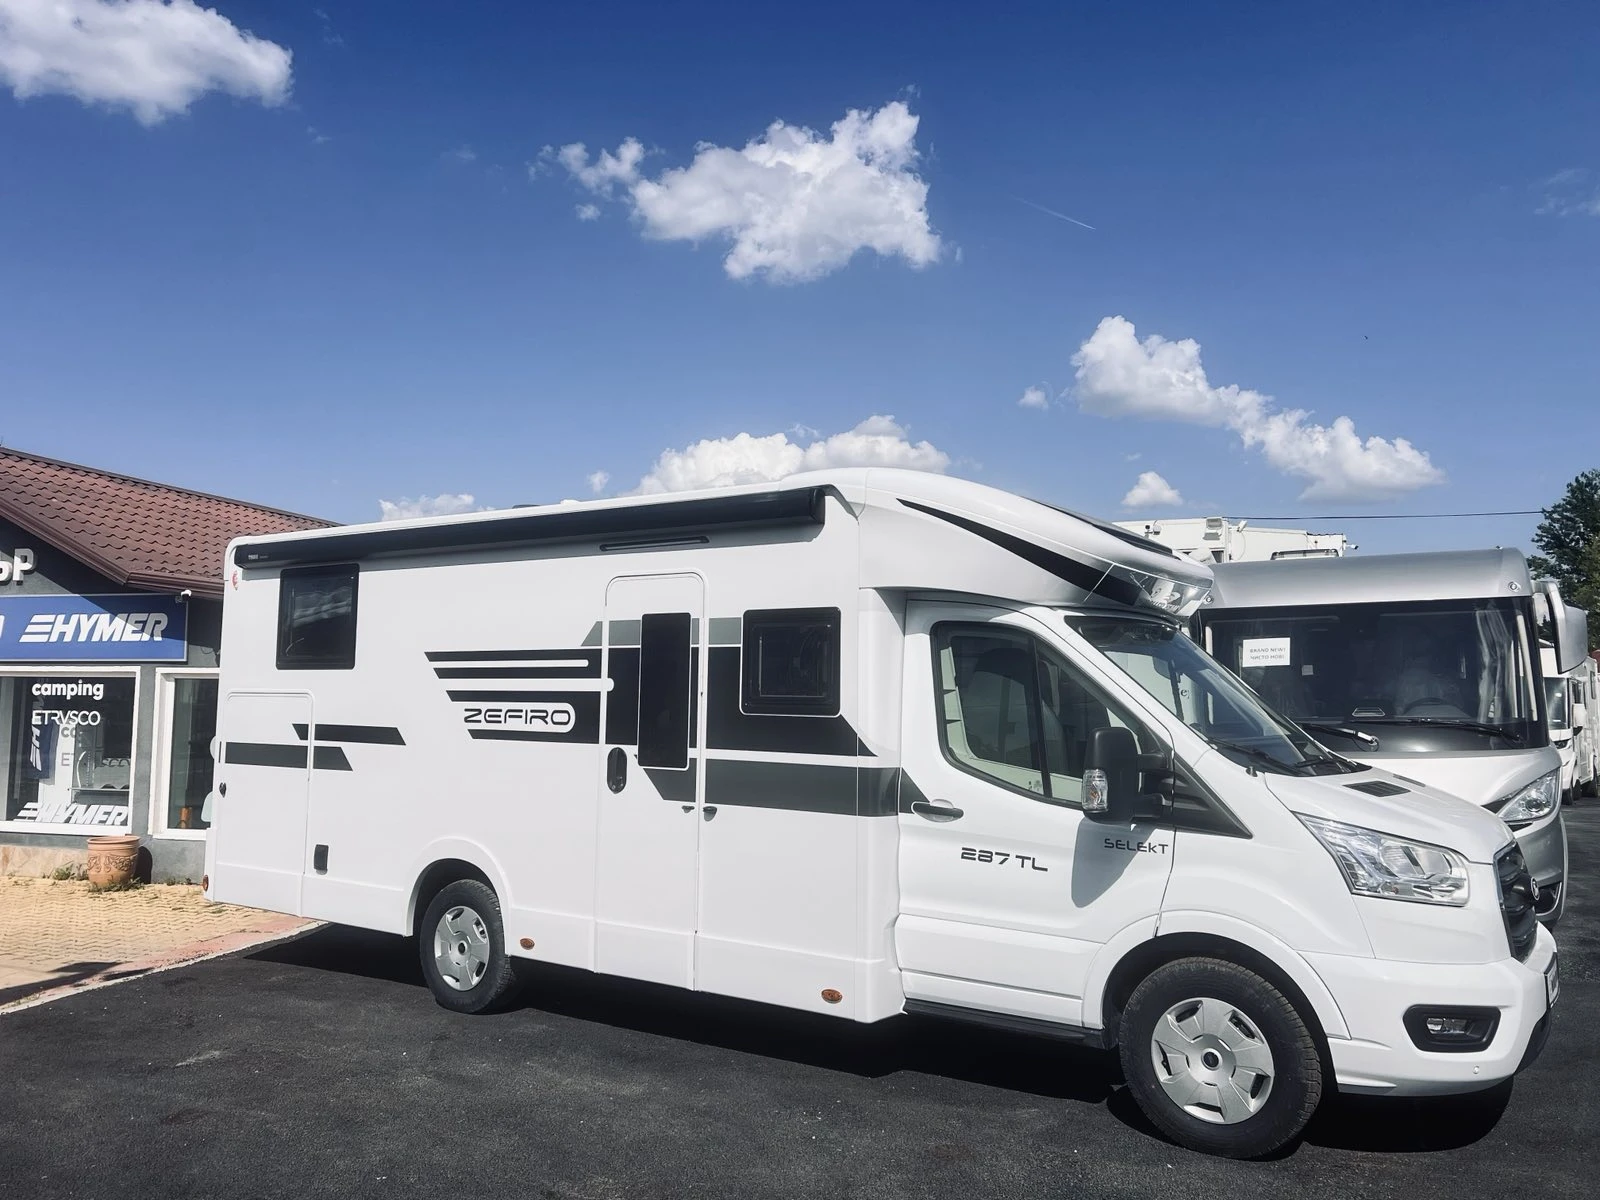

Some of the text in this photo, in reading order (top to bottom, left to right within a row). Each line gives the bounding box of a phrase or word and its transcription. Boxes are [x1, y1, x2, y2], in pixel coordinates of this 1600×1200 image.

[48, 612, 168, 643] HYMER
[31, 678, 104, 700] camping
[463, 708, 571, 726] ZEFIRO
[961, 847, 1048, 872] 287 TL
